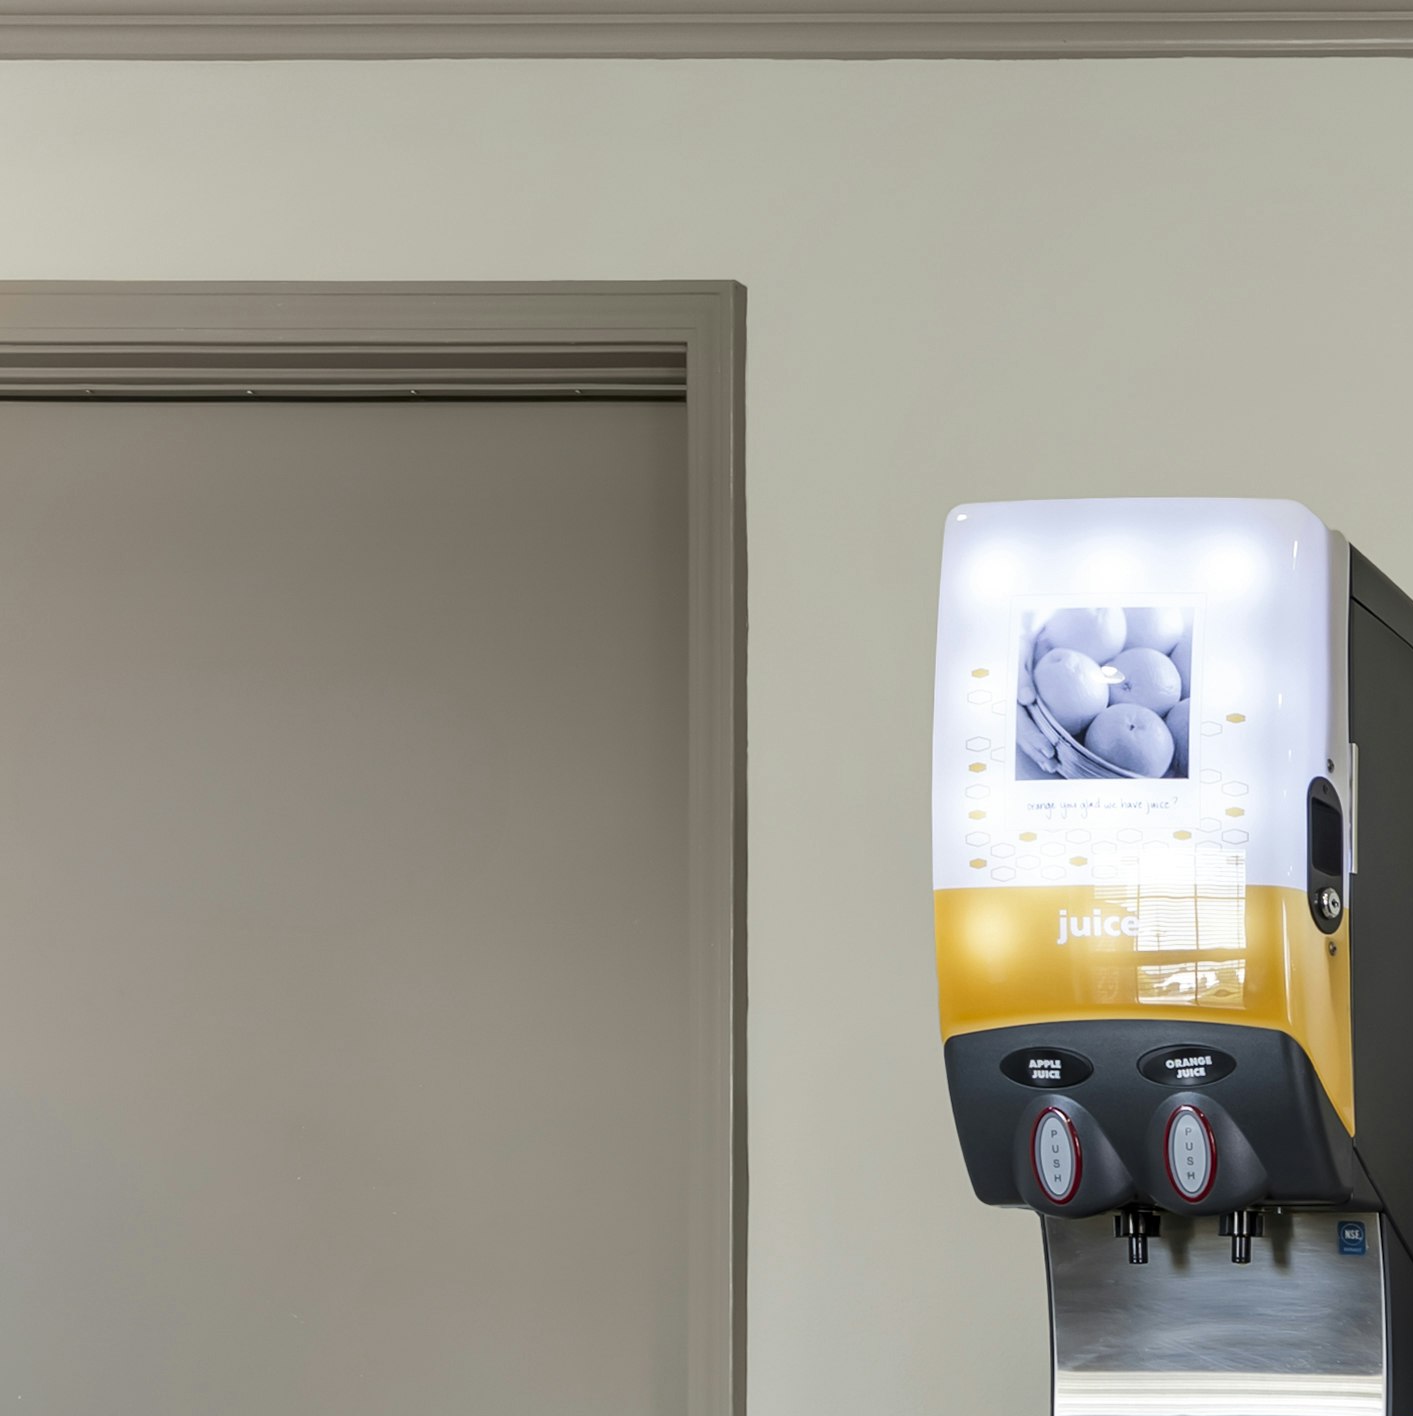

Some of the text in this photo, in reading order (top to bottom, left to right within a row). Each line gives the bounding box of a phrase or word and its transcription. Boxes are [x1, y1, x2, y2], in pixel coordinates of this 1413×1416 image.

[1104, 802, 1116, 810] we
[1120, 798, 1142, 810] have
[1057, 909, 1140, 945] juice
[1028, 1059, 1062, 1069] APPLE
[1165, 1056, 1212, 1069] ORANGE
[1032, 1069, 1061, 1080] JUICE
[1176, 1067, 1206, 1079] JUICE
[1051, 1129, 1062, 1183] PUSH
[1184, 1127, 1196, 1180] PUSH
